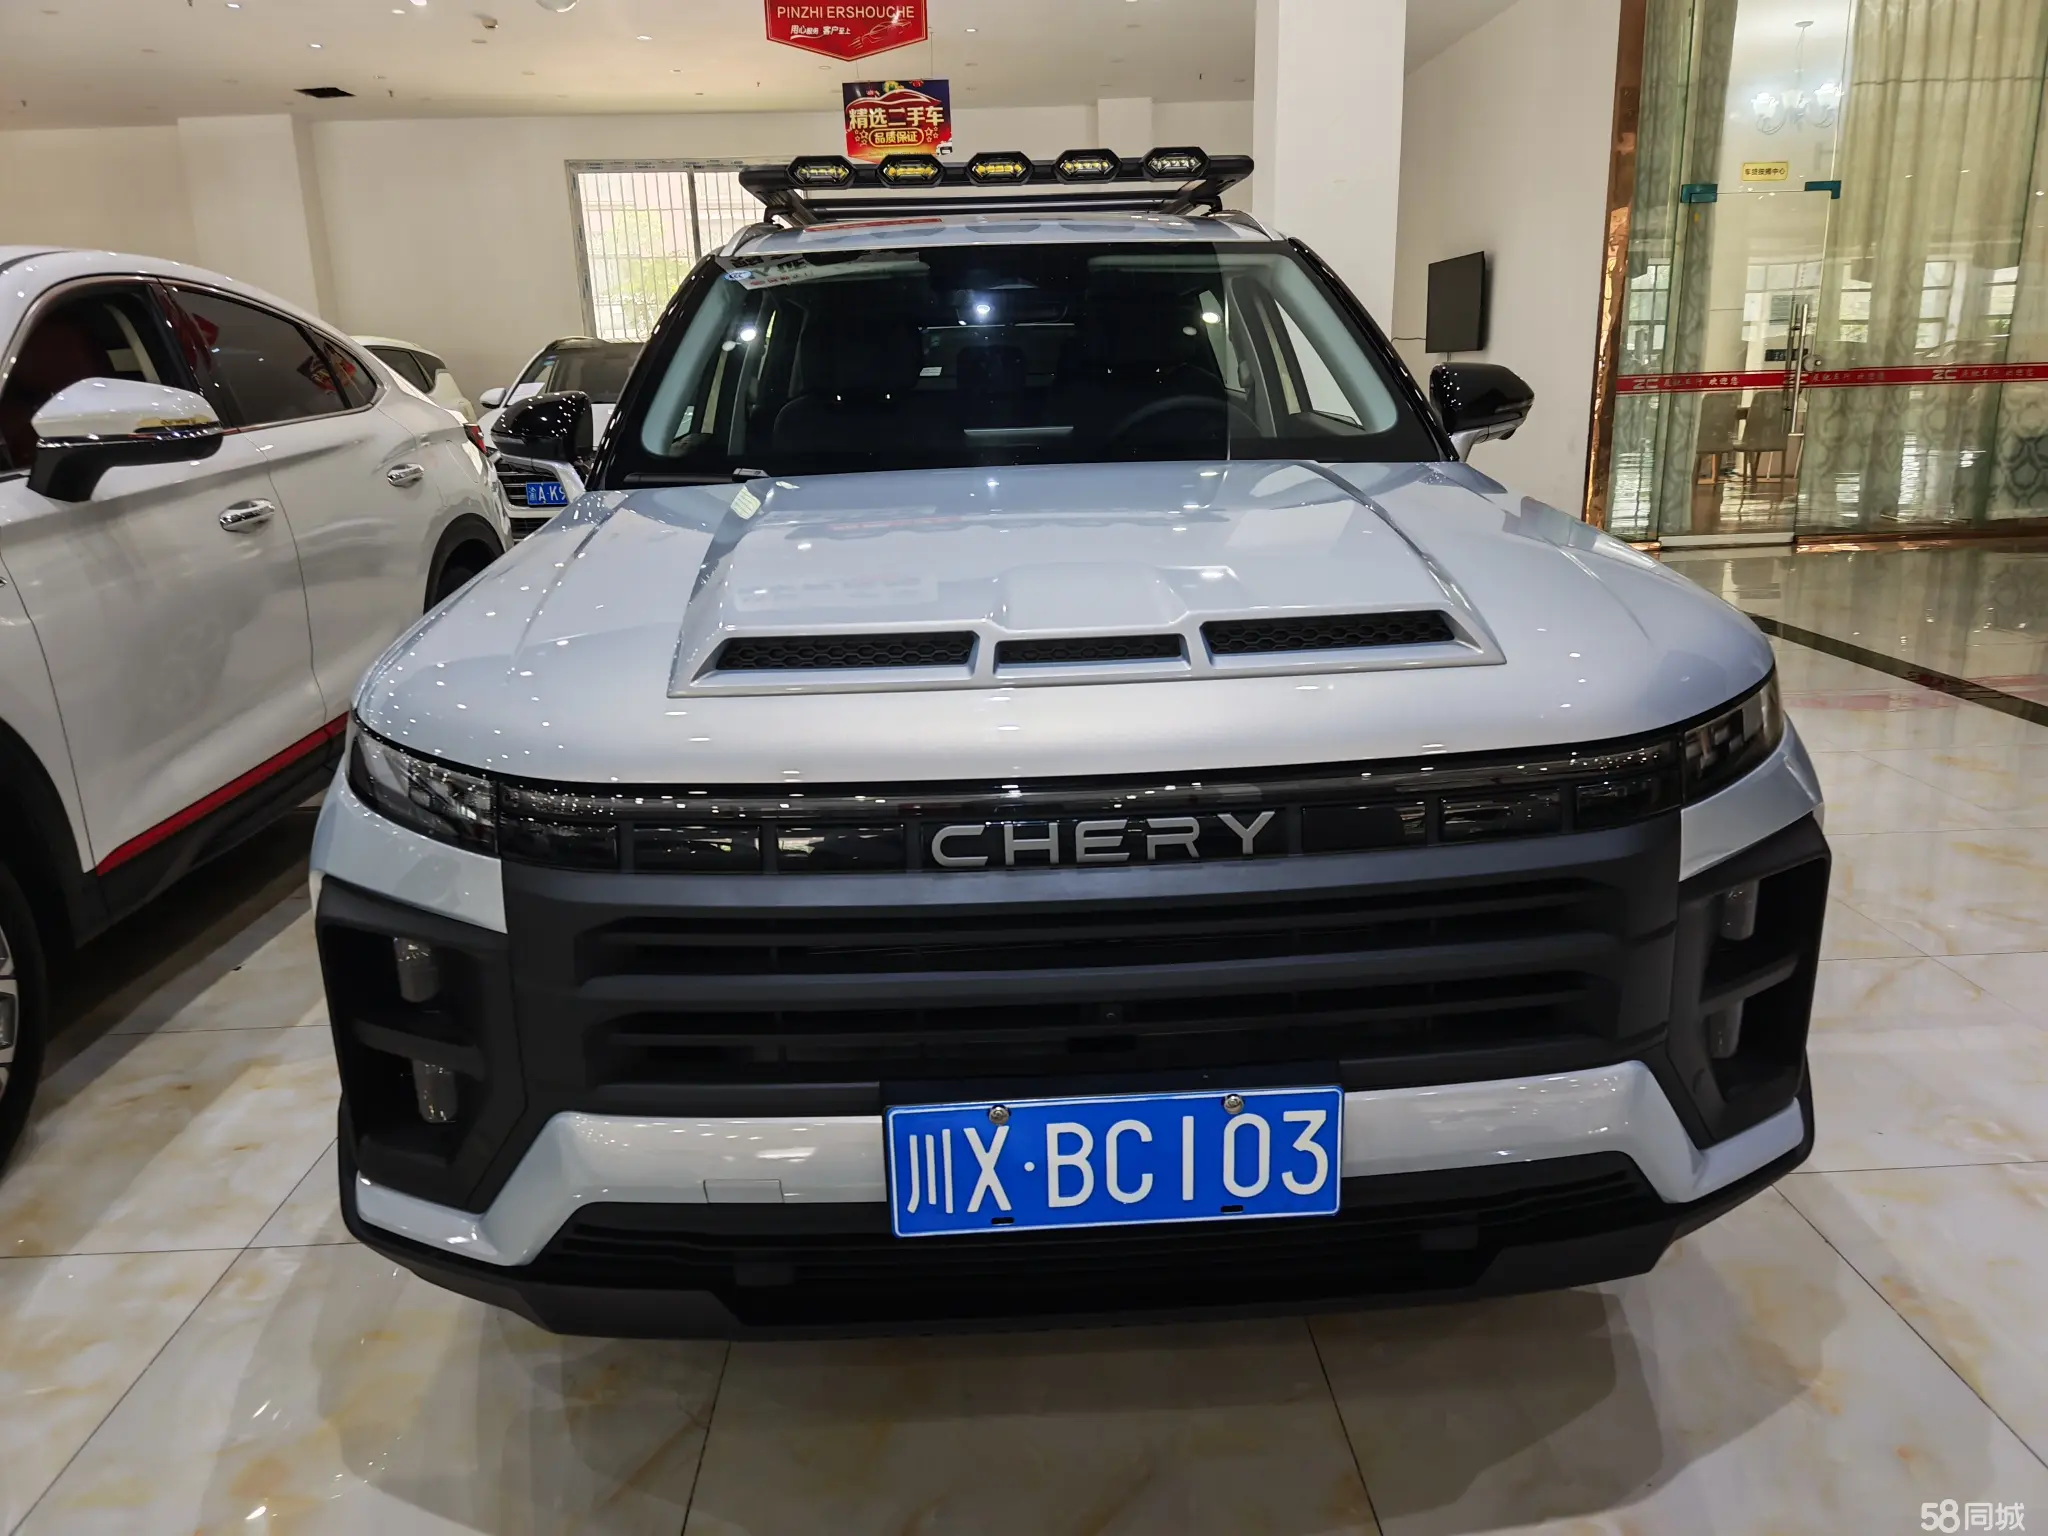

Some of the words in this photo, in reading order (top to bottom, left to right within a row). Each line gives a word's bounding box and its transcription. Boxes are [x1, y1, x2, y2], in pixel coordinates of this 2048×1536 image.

[777, 6, 823, 18] PINZHI
[826, 5, 915, 18] ERSHOUCHE
[848, 106, 945, 129] 精选二手车
[873, 130, 919, 144] 品质保证
[931, 811, 1275, 867] CHERY
[907, 1110, 1329, 1214] 川X·BC103
